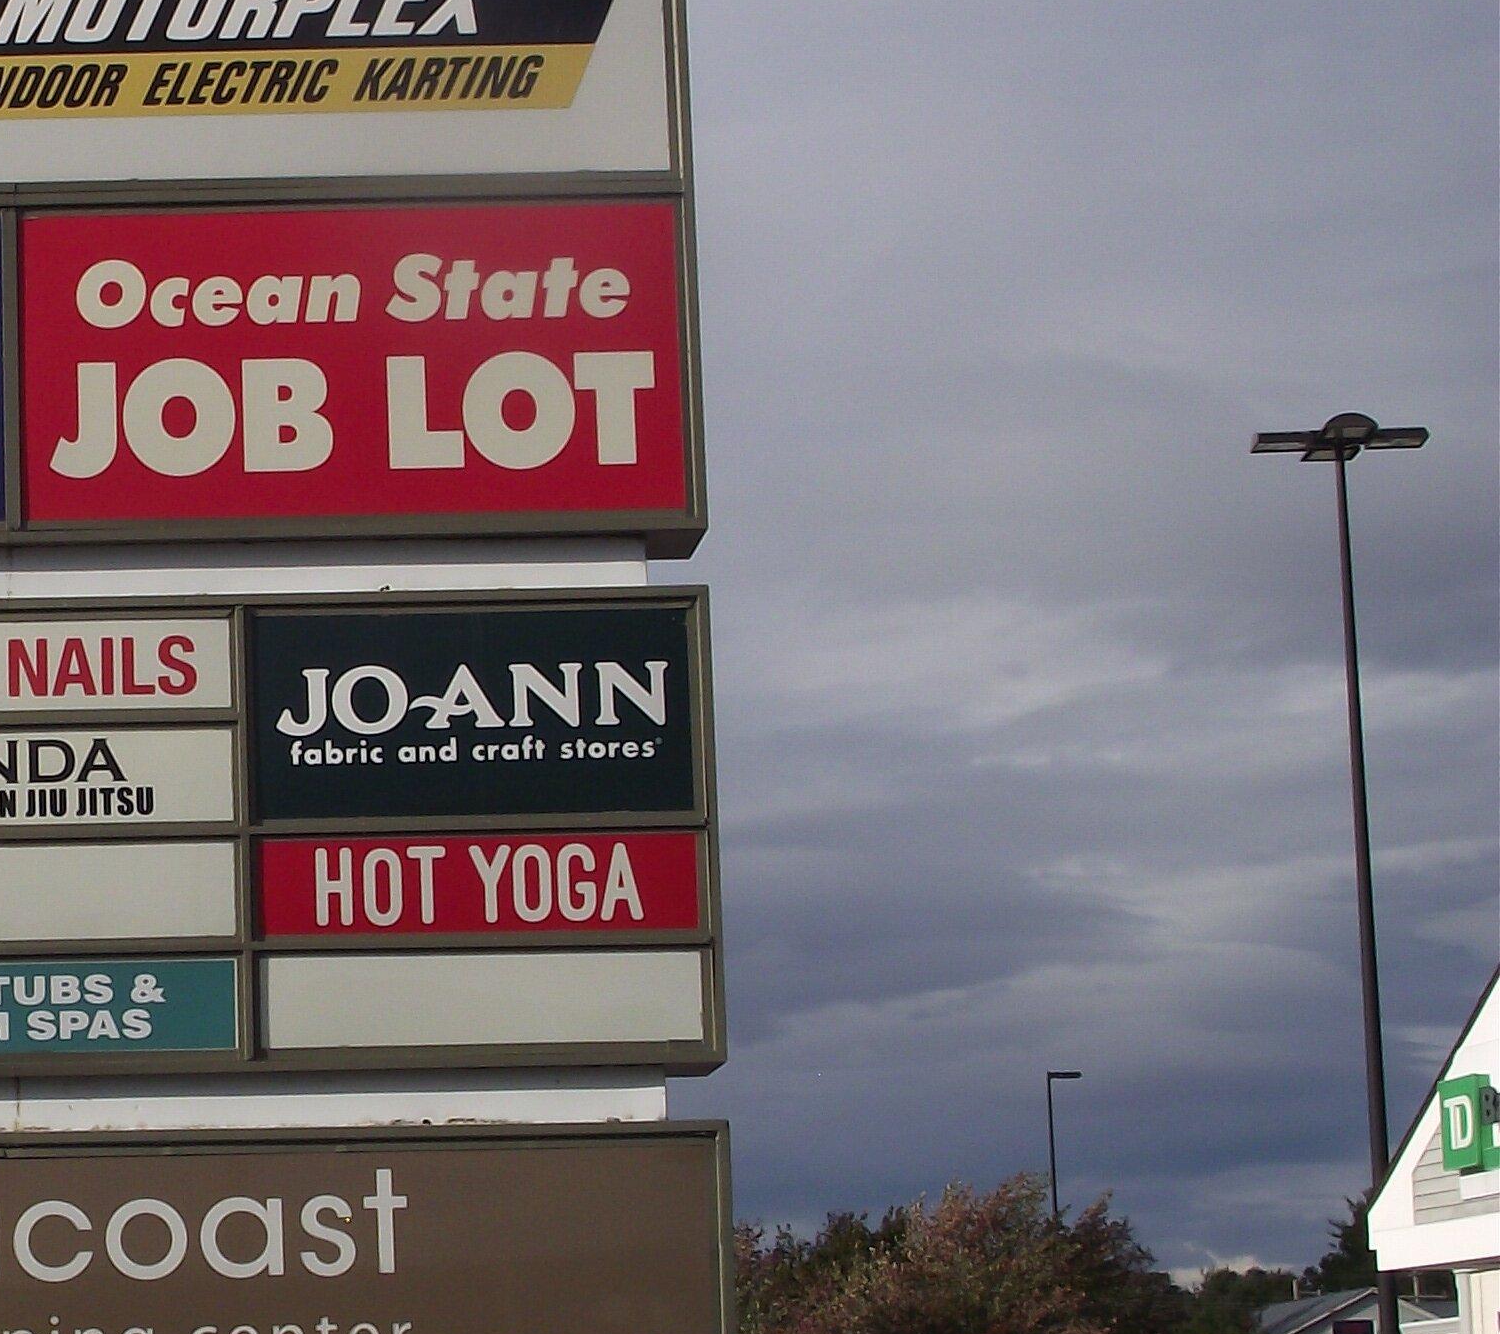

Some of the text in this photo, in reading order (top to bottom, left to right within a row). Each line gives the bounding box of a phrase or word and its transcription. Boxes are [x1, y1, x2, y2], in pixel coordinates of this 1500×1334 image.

[155, 58, 331, 105] ELECTRIC
[356, 53, 544, 101] KARTING
[77, 254, 630, 328] Ocean State
[50, 351, 654, 478] JOB LOT
[9, 636, 197, 697] NAILS
[290, 737, 382, 765] fabric
[398, 737, 457, 762] and
[473, 735, 545, 760] craft
[26, 789, 66, 817] JIU
[77, 787, 153, 816] JITSU
[315, 843, 643, 926] HOT YOGA
[130, 974, 165, 1005] &
[27, 1010, 152, 1040] SPAS
